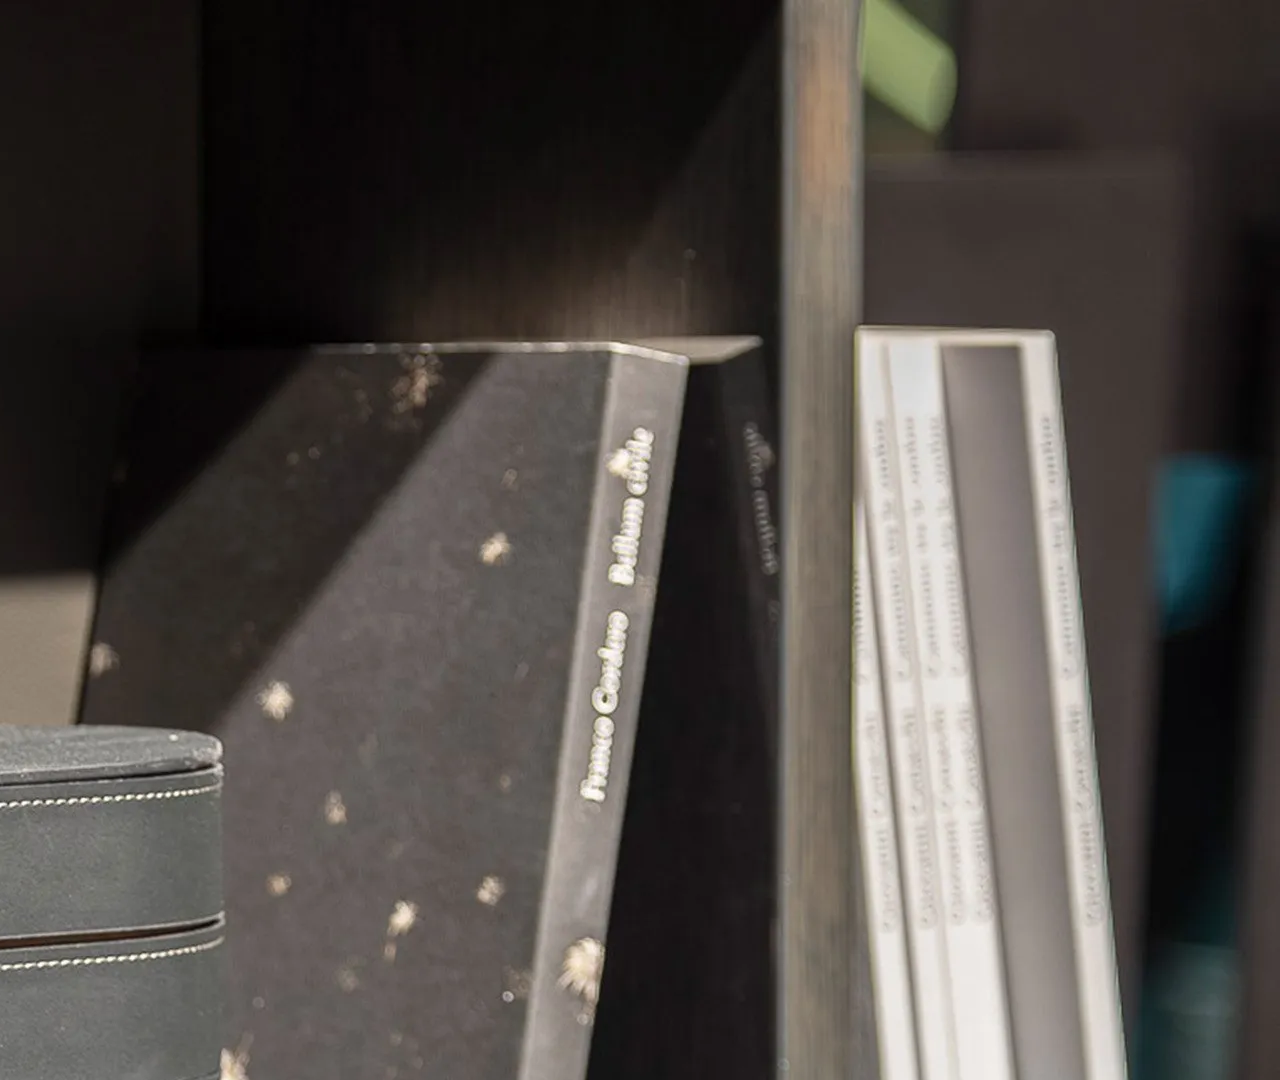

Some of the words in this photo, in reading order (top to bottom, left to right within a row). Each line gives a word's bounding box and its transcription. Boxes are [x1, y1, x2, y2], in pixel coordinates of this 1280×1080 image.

[607, 497, 646, 586] Bellum
[591, 610, 630, 715] Cordero
[580, 715, 615, 801] Franco
